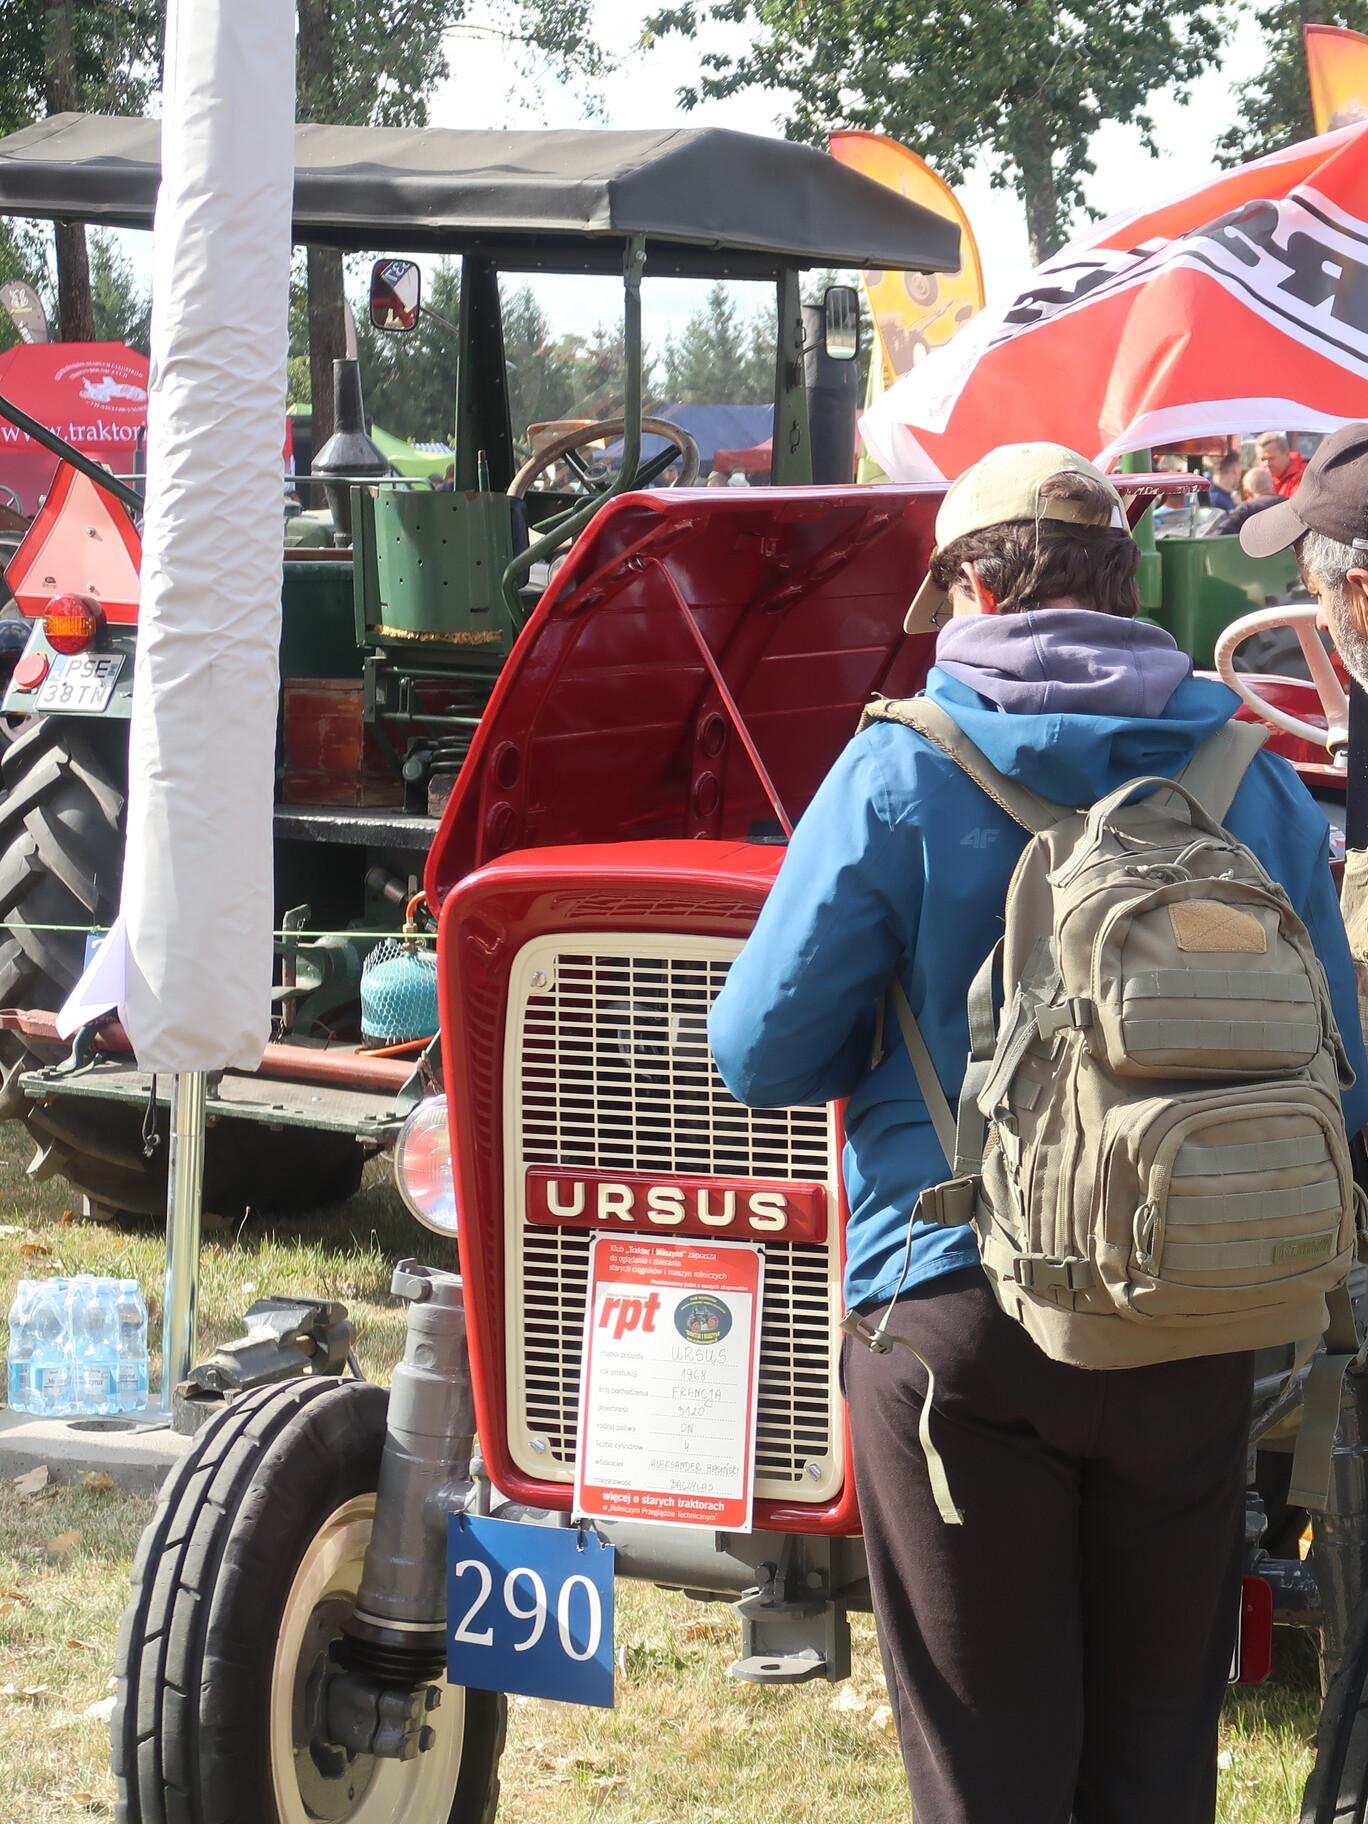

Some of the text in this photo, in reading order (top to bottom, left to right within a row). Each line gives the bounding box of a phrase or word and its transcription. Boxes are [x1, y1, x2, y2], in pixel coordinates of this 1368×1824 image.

[65, 660, 111, 678] PSE
[44, 684, 107, 705] 38TN
[960, 827, 1000, 849] 4F
[546, 1180, 788, 1231] URSUS
[610, 1244, 625, 1252] Klub
[688, 1252, 717, 1260] zaprasza
[619, 1255, 648, 1264] oglądania
[653, 1258, 681, 1267] zbierania
[609, 1264, 631, 1273] starych
[632, 1266, 663, 1275] ciągników
[668, 1269, 692, 1278] maszyn
[694, 1271, 728, 1281] rolniczych
[599, 1292, 661, 1340] rpt
[621, 1352, 644, 1361] pojazdu
[671, 1346, 727, 1364] URSUS
[611, 1369, 638, 1378] produkcji
[680, 1368, 707, 1382] 1968
[599, 1387, 648, 1397] kraj pochodzenia
[598, 1404, 629, 1414] pojemność
[597, 1423, 636, 1432] rodzaj paliwa
[680, 1423, 694, 1433] ON
[596, 1440, 643, 1451] liczba cylindrów
[684, 1440, 690, 1452] 4
[595, 1458, 624, 1467] właściciel
[594, 1477, 632, 1487] miejscowość
[602, 1491, 725, 1511] więcej o starych traktorach
[642, 1507, 675, 1518] Przeglądzie
[454, 1559, 602, 1662] 290
